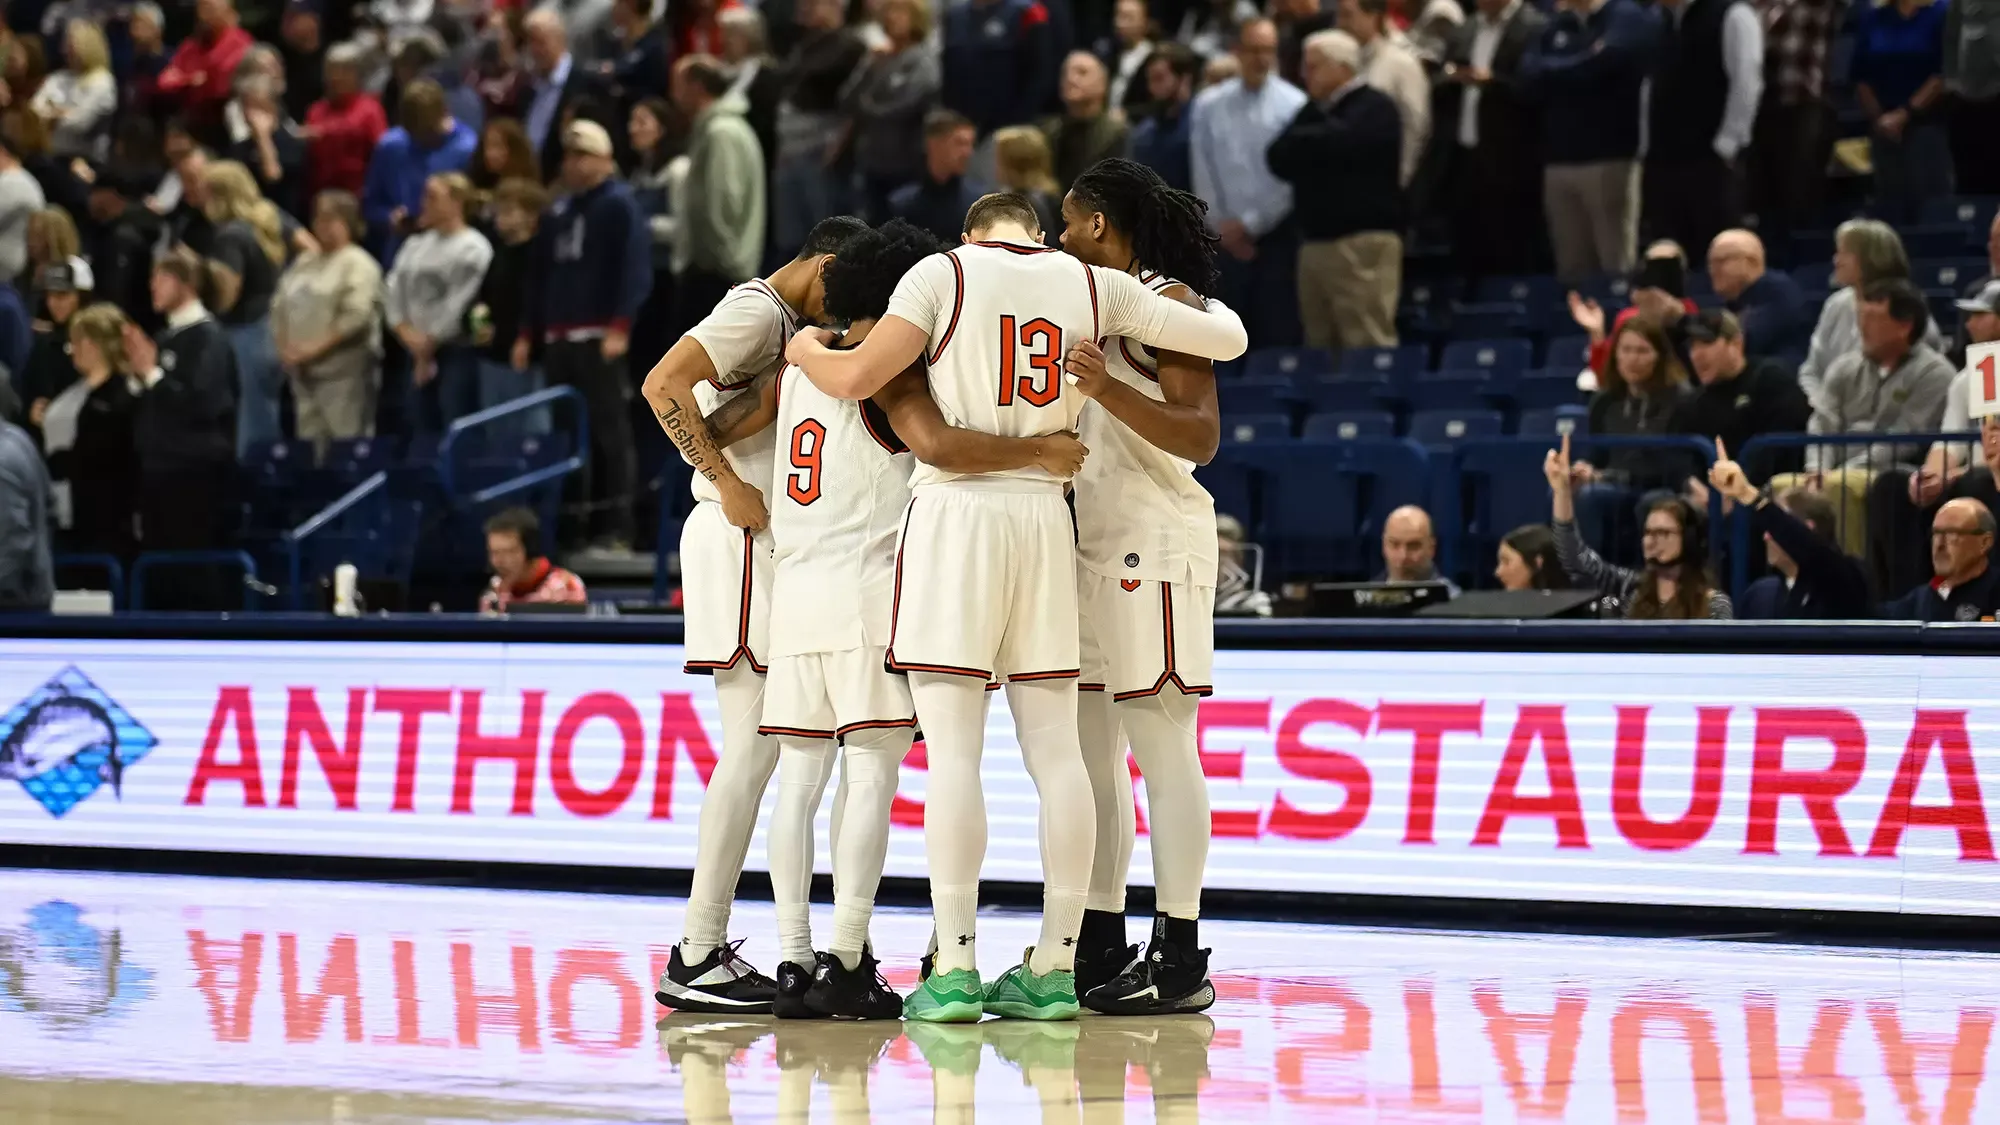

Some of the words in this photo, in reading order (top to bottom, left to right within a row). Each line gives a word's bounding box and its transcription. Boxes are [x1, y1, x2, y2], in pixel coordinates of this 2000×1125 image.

[997, 314, 1063, 408] 13
[1975, 354, 1996, 402] 1
[655, 397, 704, 467] Joshua
[787, 418, 827, 506] 9
[183, 684, 929, 830] ANTHON
[1126, 697, 1998, 862] ESTAURA
